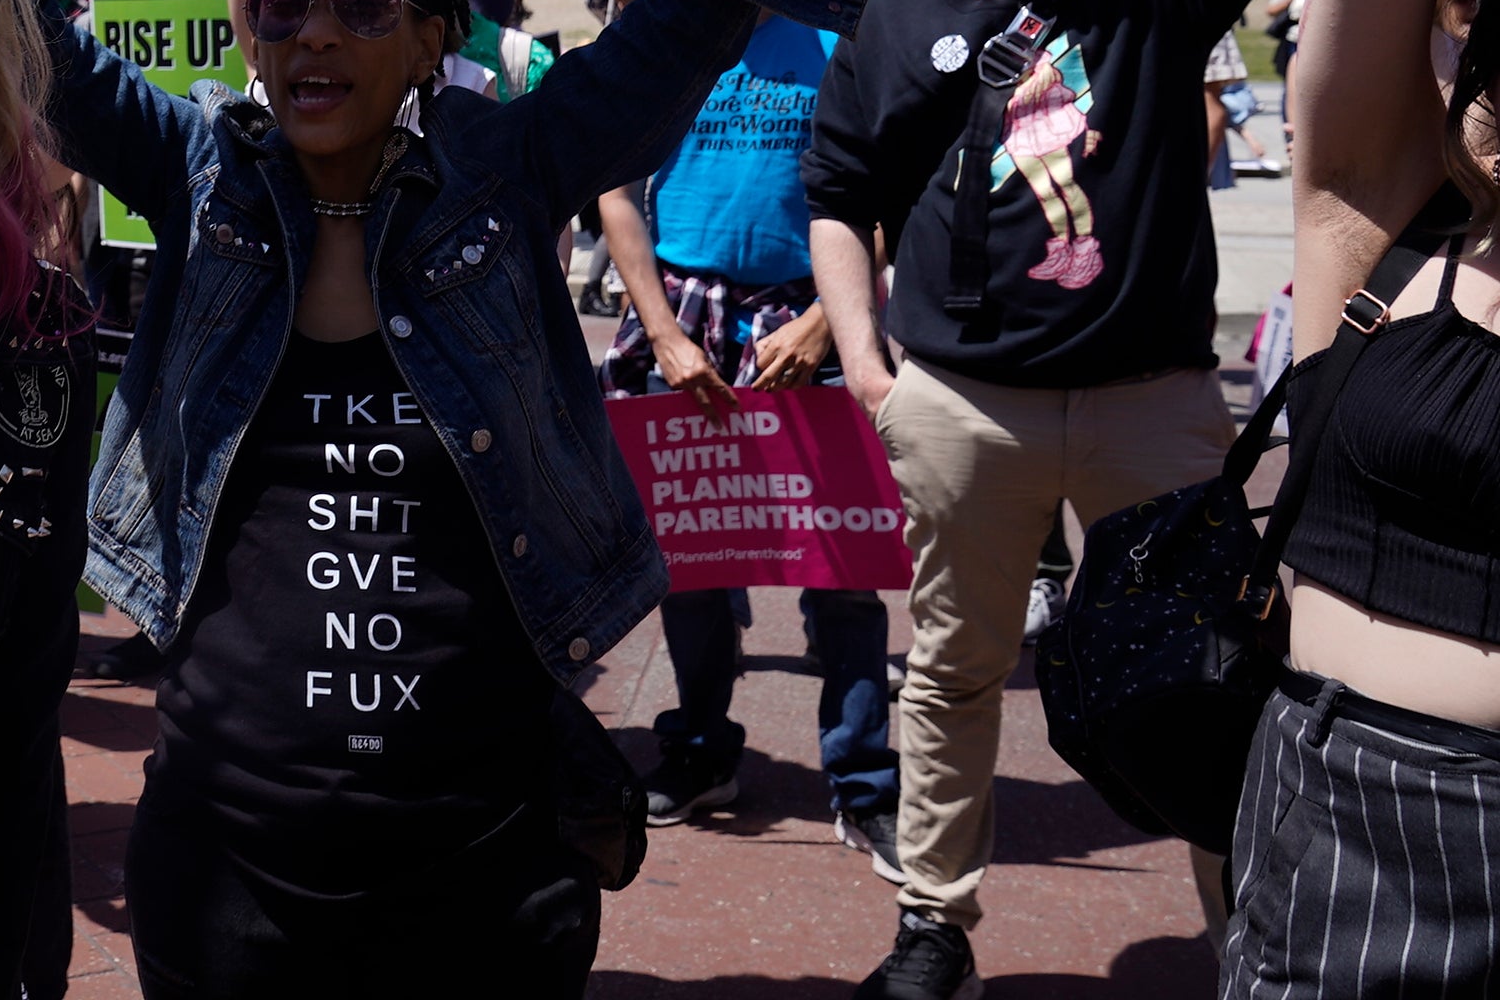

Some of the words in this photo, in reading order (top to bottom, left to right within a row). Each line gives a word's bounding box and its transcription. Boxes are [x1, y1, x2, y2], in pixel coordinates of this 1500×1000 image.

[104, 19, 175, 69] RISE
[186, 18, 235, 68] UP
[705, 95, 741, 113] ore
[743, 91, 818, 117] Right
[690, 118, 727, 135] an
[729, 114, 812, 135] Wome
[698, 138, 733, 151] THIS
[747, 137, 806, 151] AMERI
[303, 392, 422, 425] TKE
[20, 426, 34, 441] AT
[35, 427, 54, 443] SEA
[646, 420, 657, 444] I
[665, 411, 781, 443] STAND
[324, 443, 405, 477] NO
[650, 444, 741, 474] WITH
[652, 473, 814, 506] PLANNED
[307, 492, 421, 534] SHT
[655, 505, 899, 537] PARENTHOOD
[306, 551, 417, 593] GVE
[672, 549, 724, 566] Planned
[725, 546, 805, 562] Parenthood
[325, 611, 402, 652] NO
[306, 670, 421, 712] FUX
